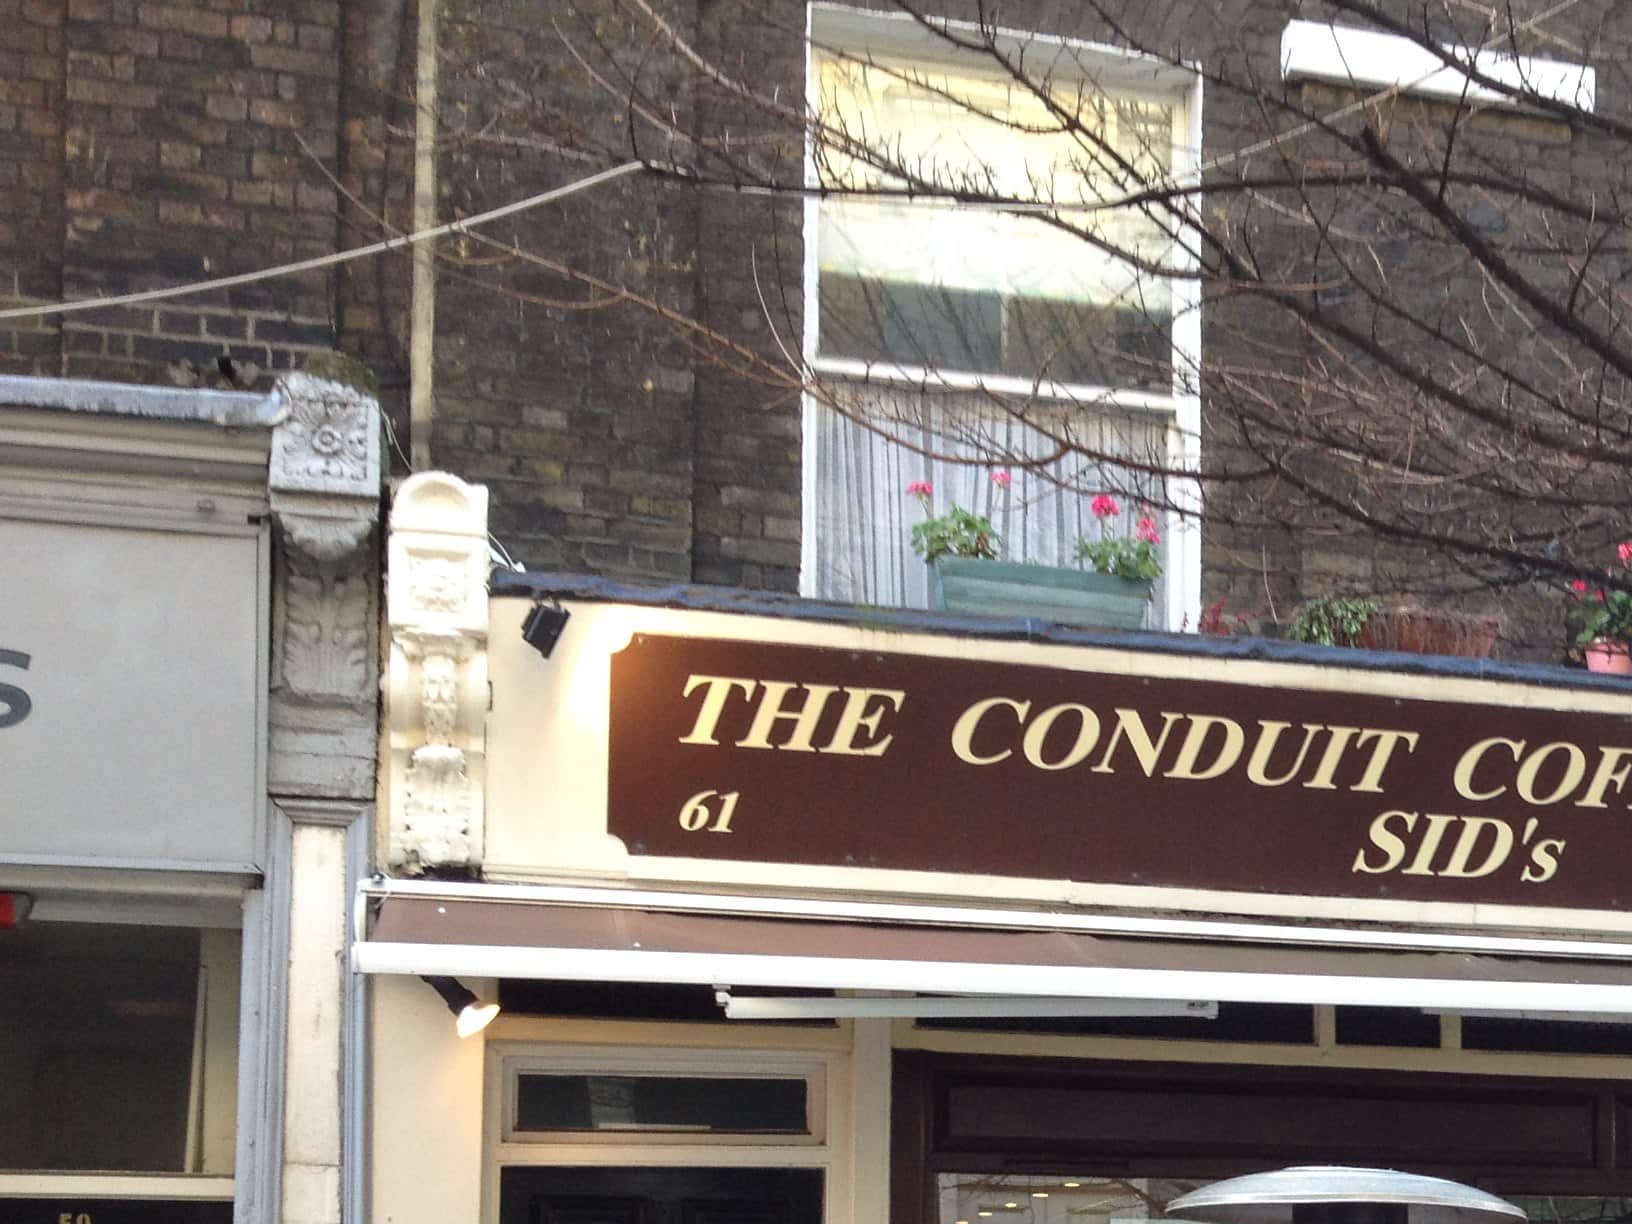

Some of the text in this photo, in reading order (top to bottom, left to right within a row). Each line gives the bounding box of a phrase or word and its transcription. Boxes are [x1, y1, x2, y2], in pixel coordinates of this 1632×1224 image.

[679, 674, 906, 757] THE
[951, 697, 1420, 793] CONDUIT
[678, 789, 742, 834] 61
[1352, 810, 1566, 884] SID's
